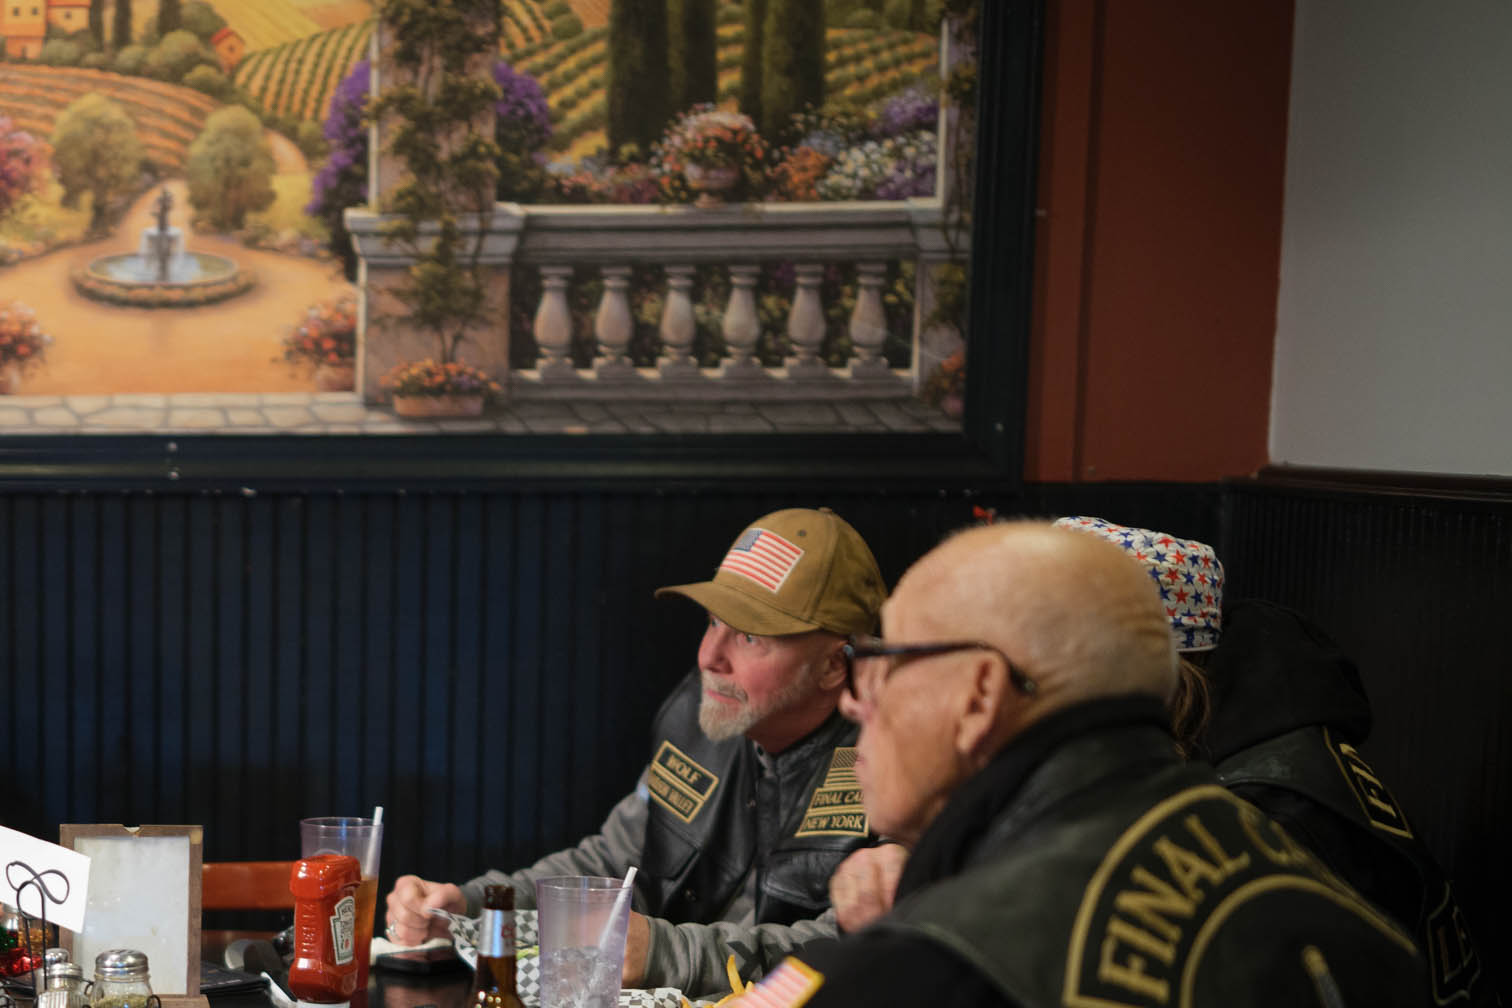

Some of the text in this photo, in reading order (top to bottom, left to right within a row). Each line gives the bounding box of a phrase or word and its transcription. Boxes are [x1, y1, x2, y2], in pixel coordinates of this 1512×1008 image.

[666, 754, 702, 784] WOLF
[814, 791, 842, 806] FINAL
[801, 814, 864, 831] NEW YORK
[1097, 812, 1252, 1005] FINAL
